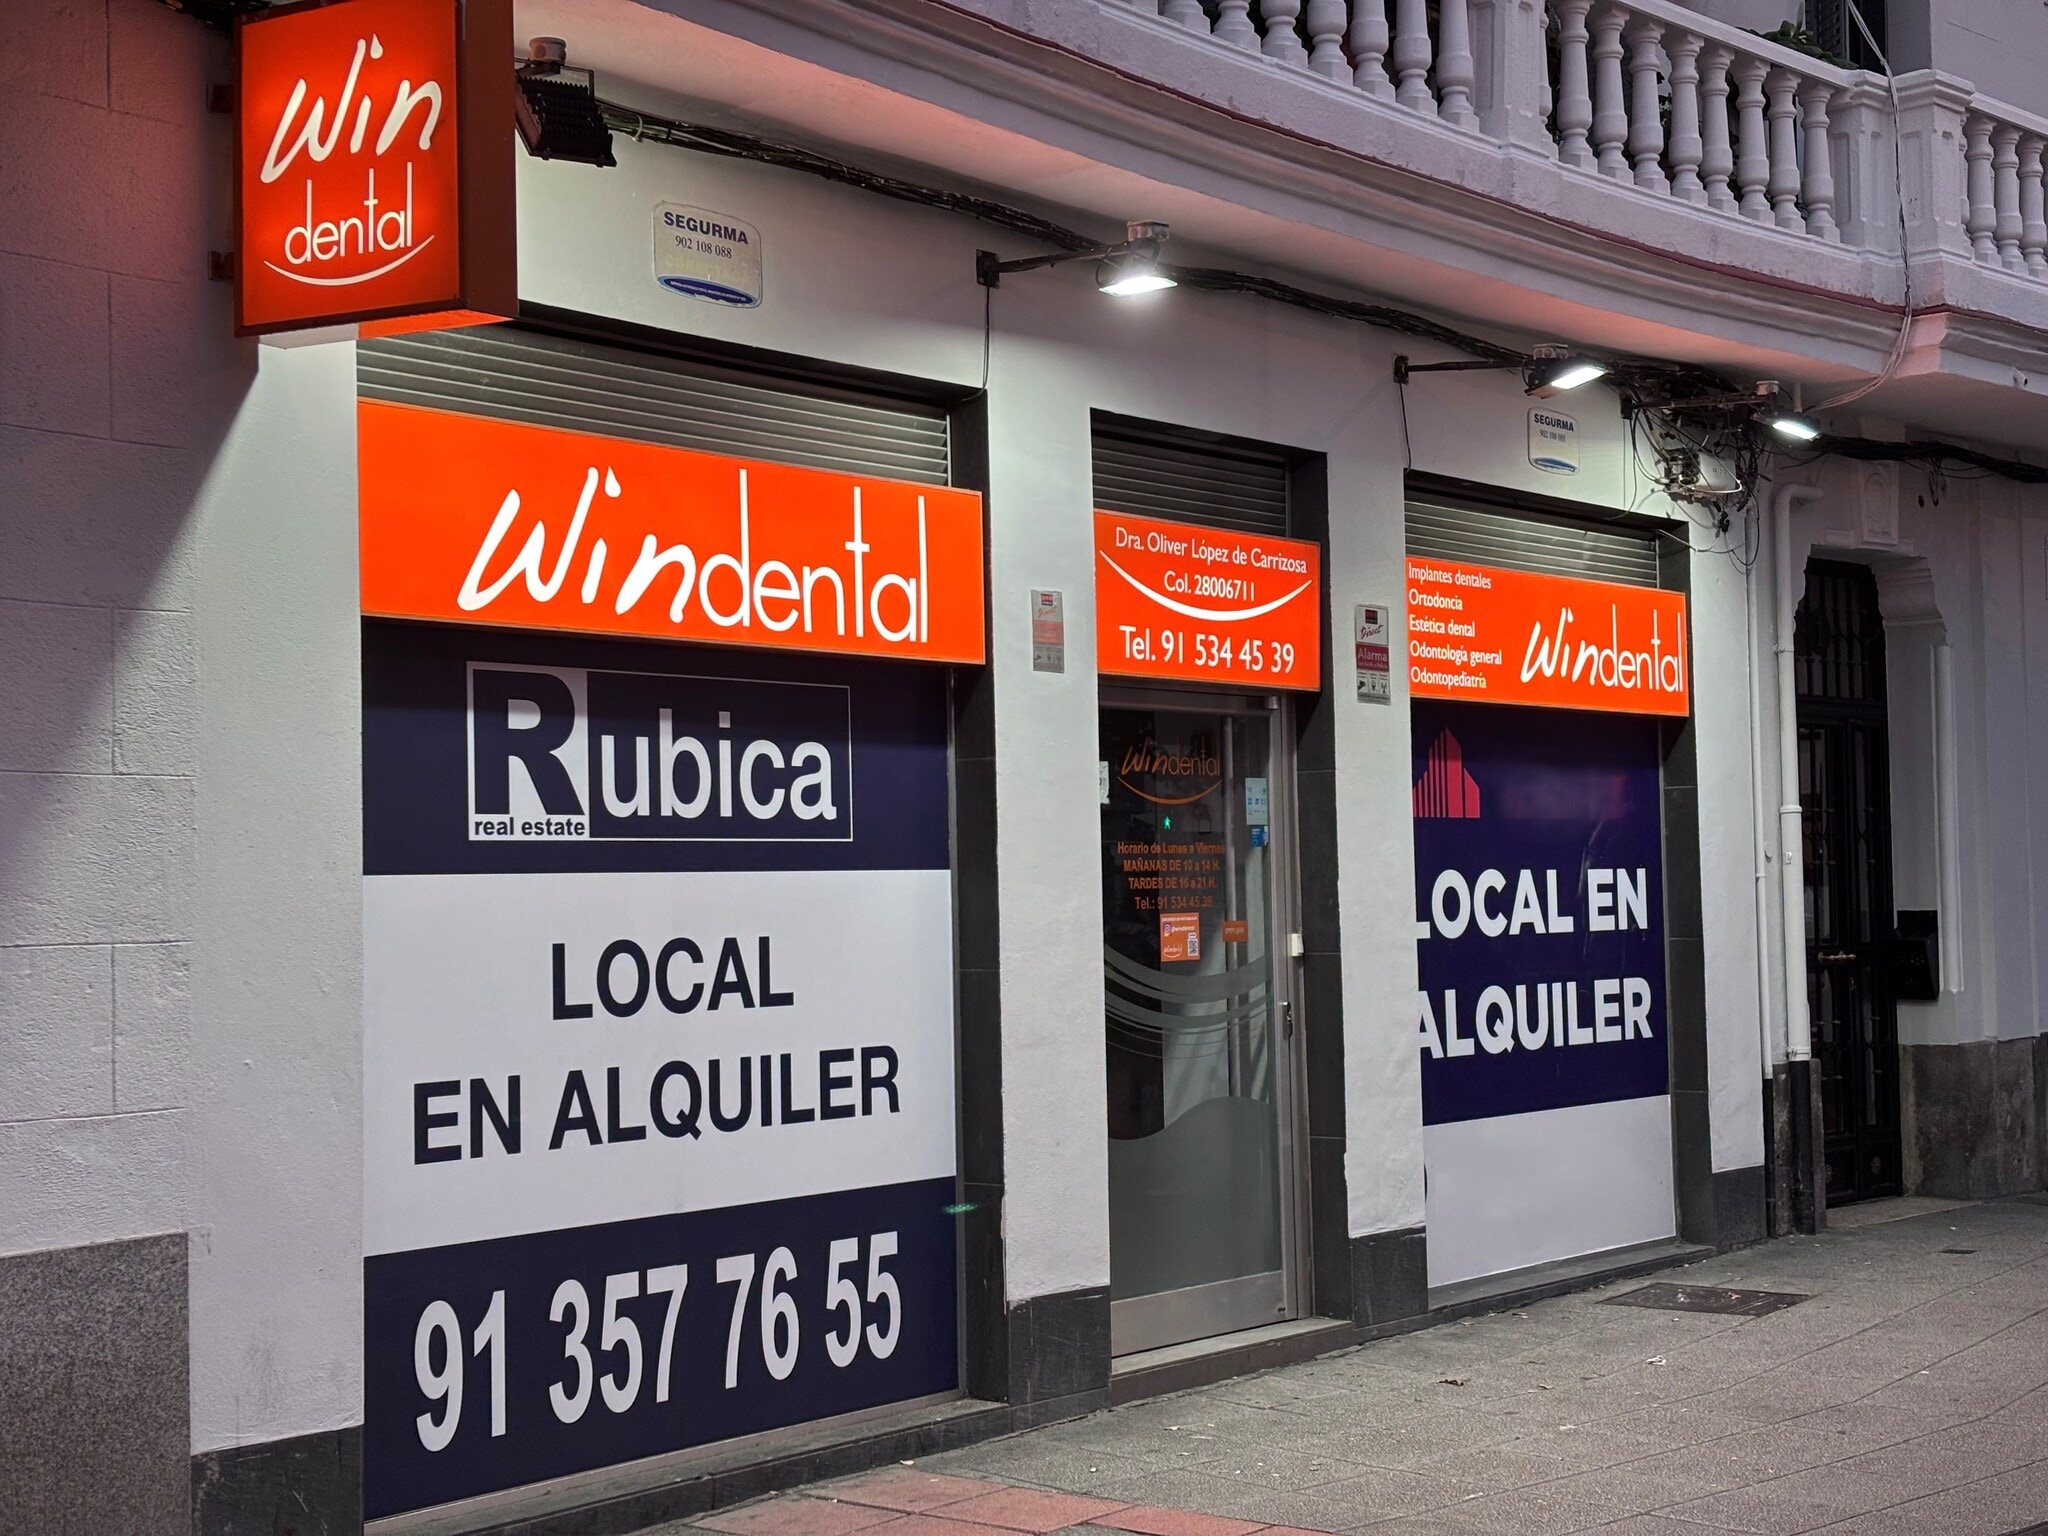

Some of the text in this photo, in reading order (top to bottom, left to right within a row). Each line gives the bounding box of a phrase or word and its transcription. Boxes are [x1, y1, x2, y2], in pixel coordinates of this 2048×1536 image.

[260, 33, 442, 184] Win
[284, 161, 412, 265] dental
[663, 211, 749, 245] SEGURMA
[675, 235, 732, 259] 902 108 088
[1534, 413, 1574, 432] SEGURMA
[457, 466, 928, 643] Windental
[1115, 526, 1307, 574] Dra. Oliver López de Carrizosa
[1163, 570, 1255, 602] Col. 28006711
[1408, 561, 1491, 590] Implantes dentales
[1409, 588, 1463, 611] Ortodoncia
[1409, 613, 1475, 637] Estética dental
[1119, 624, 1295, 674] Tel. 91 534 45 39
[1358, 646, 1387, 662] Alarma
[1410, 640, 1502, 667] Odontología general
[1520, 603, 1683, 693] Windental
[1410, 666, 1487, 691] Odontopediatría
[473, 668, 837, 821] Rubica
[1120, 735, 1220, 776] Windental
[474, 817, 585, 836] real estate
[1117, 841, 1149, 855] Horario
[1150, 841, 1161, 855] de
[1163, 841, 1188, 854] Lunes
[1189, 844, 1194, 854] a
[1123, 858, 1167, 872] MAÑANAS
[1169, 859, 1181, 871] DE
[1183, 859, 1193, 871] 10
[1194, 862, 1200, 871] a
[1201, 859, 1211, 871] 14
[1128, 877, 1163, 890] TARDES
[1165, 877, 1177, 889] DE
[1190, 879, 1196, 888] a
[1134, 896, 1155, 910] Tel.:
[1157, 896, 1168, 909] 91
[1171, 896, 1186, 909] 534
[1416, 868, 1648, 939] OCAL EN
[551, 936, 795, 1021] LOCAL
[1418, 976, 1654, 1059] ALQUILER
[413, 1045, 901, 1165] EN ALQUILER
[413, 1230, 902, 1453] 91 357 76 55
